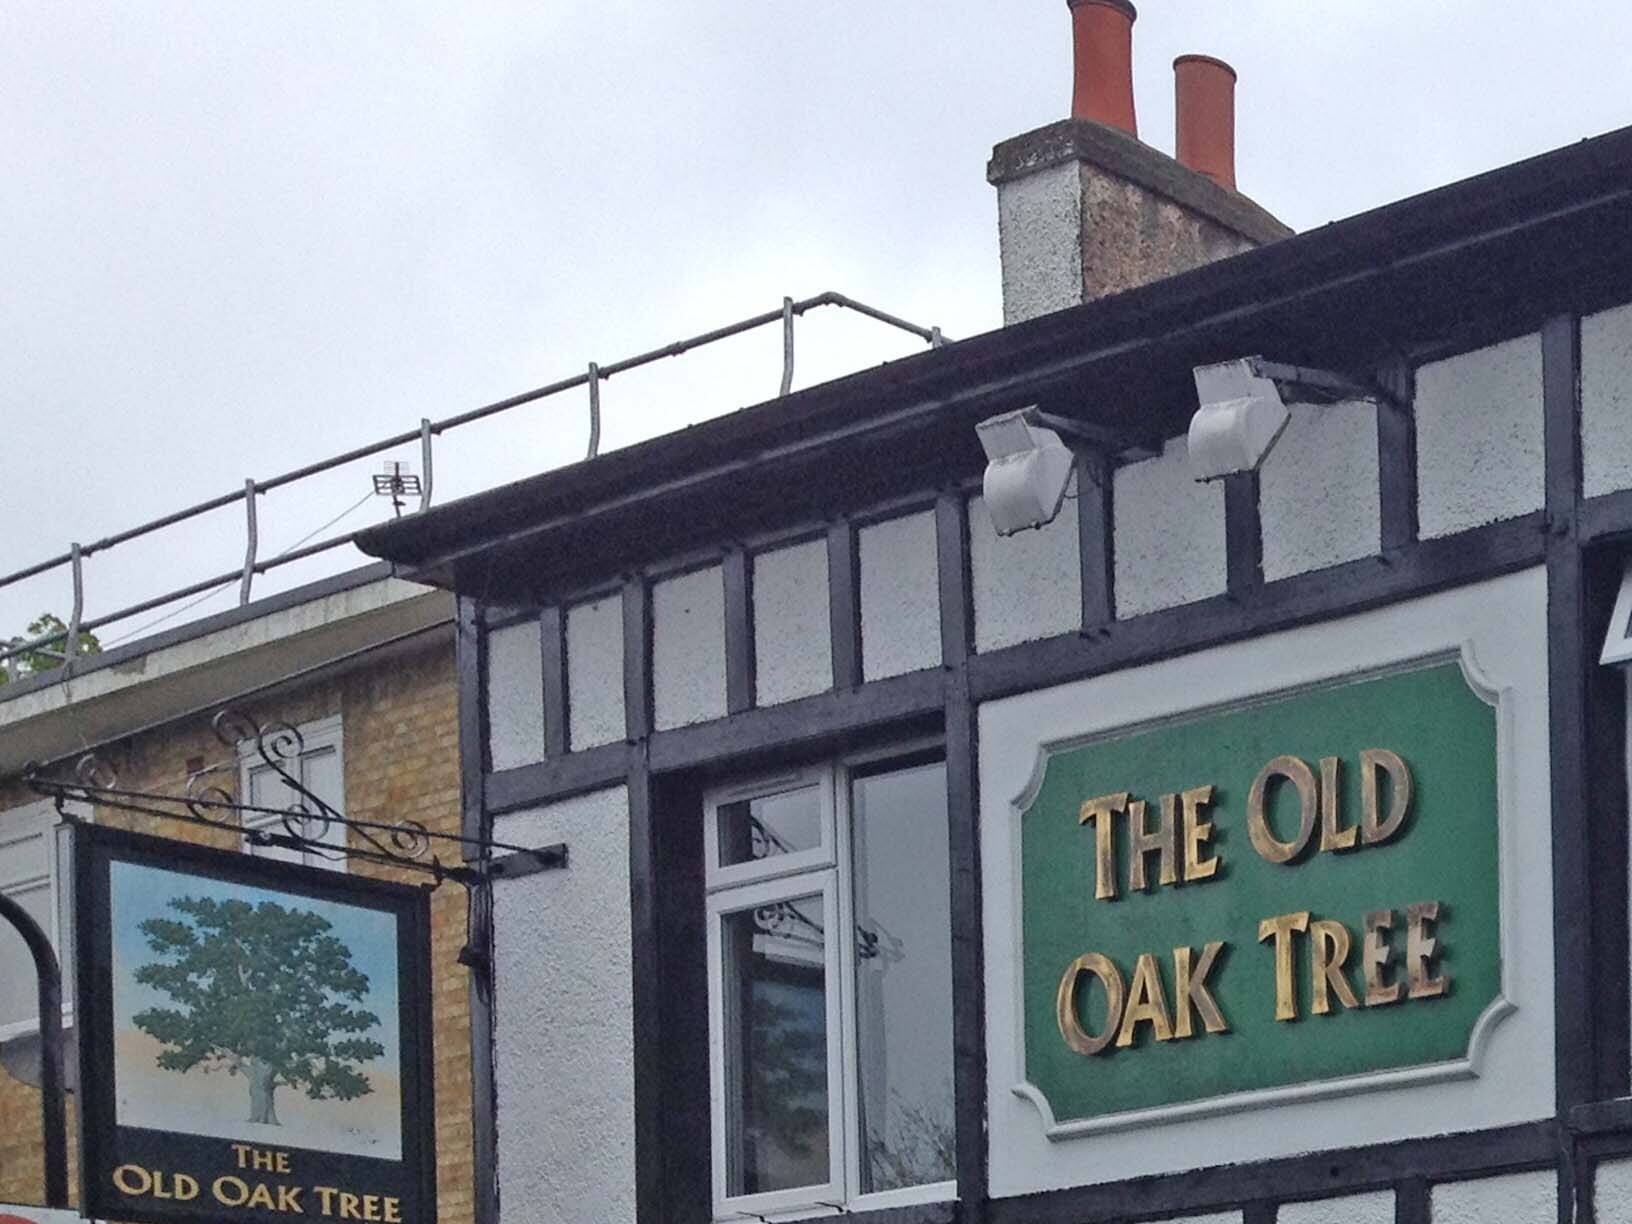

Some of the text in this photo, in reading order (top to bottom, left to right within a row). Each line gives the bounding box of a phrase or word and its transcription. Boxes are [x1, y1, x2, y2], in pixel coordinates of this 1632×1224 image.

[1079, 748, 1415, 900] THE OLD
[1056, 900, 1450, 1055] OAK TREE
[112, 1164, 402, 1223] OLD OAK TREE
[232, 1144, 291, 1174] THE
